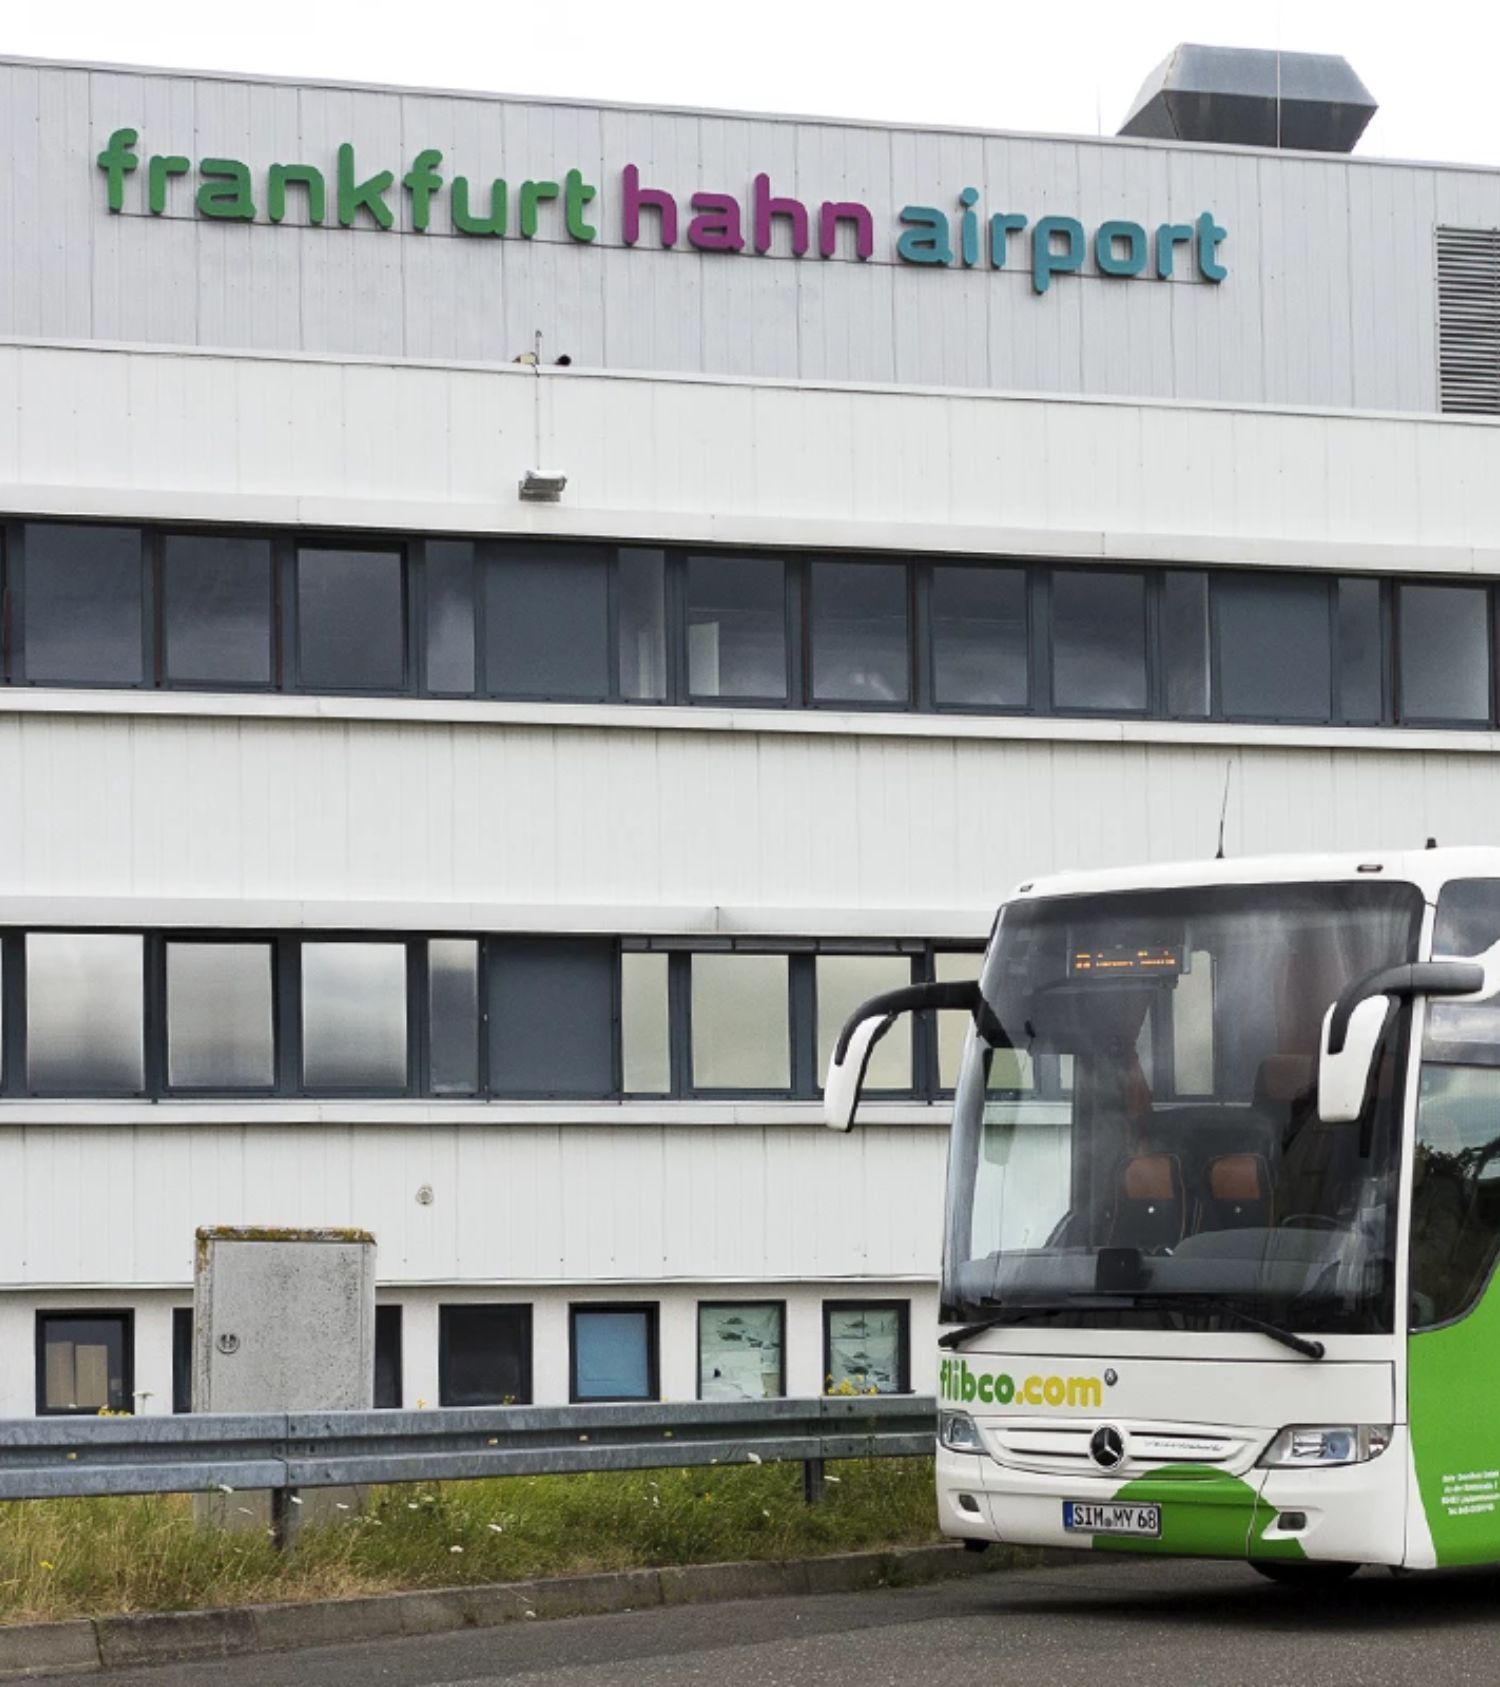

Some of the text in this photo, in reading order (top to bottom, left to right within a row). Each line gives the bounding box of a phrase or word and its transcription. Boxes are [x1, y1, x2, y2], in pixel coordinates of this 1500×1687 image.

[97, 127, 1228, 295] frankfurt hahn airport
[940, 1359, 1103, 1408] flibco.com
[1137, 1509, 1157, 1530] 68
